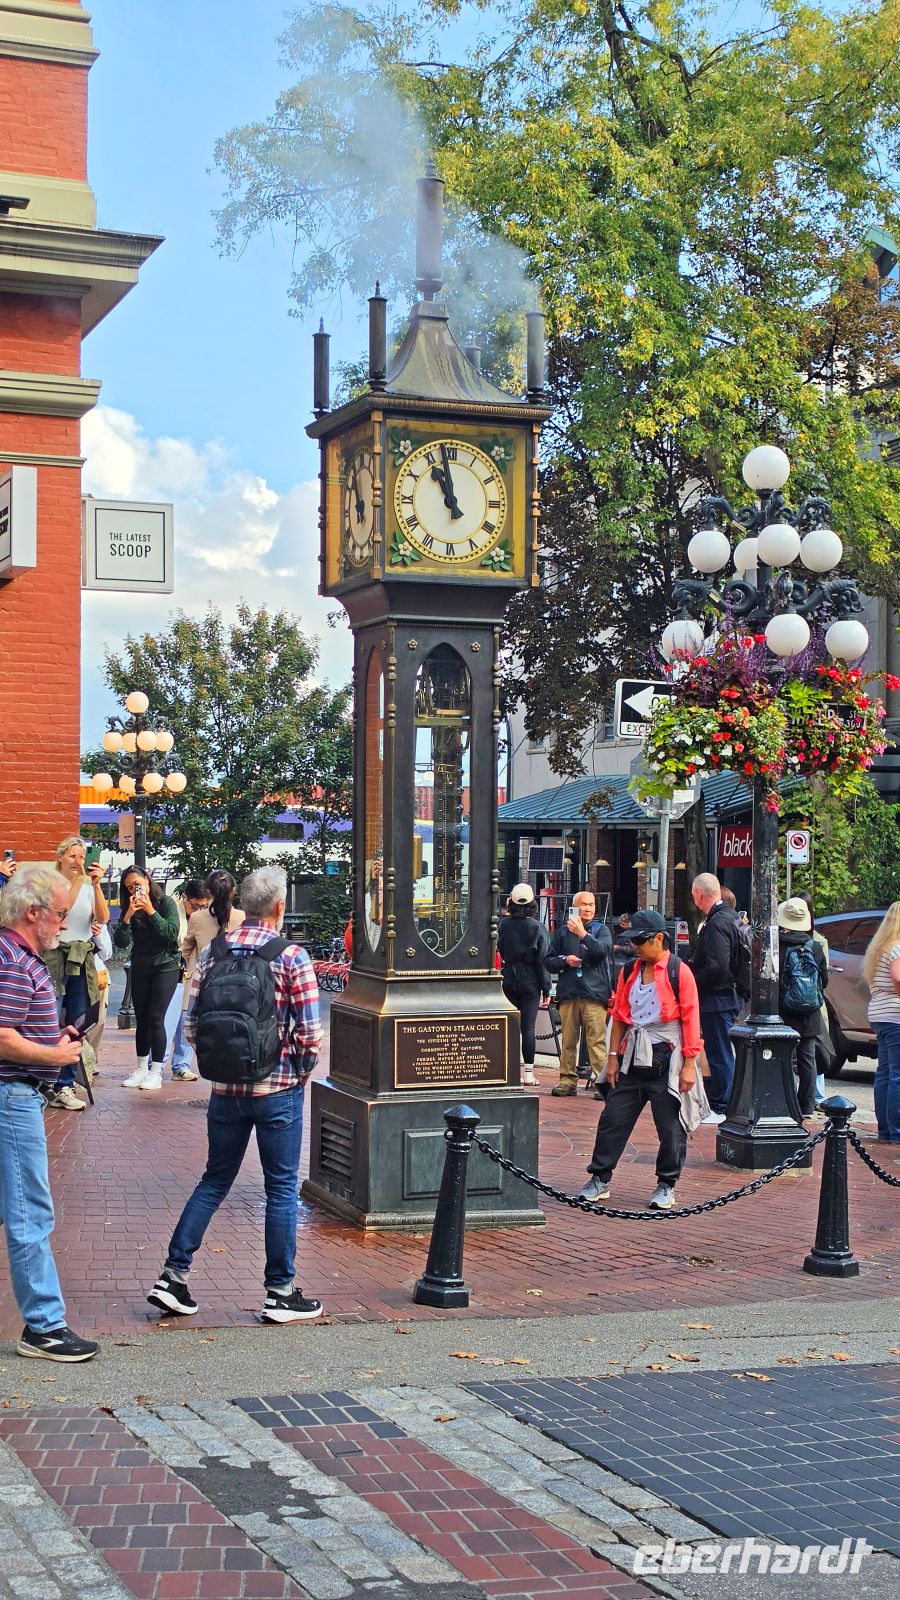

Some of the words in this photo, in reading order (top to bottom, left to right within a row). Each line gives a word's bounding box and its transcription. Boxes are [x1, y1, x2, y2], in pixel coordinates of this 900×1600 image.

[110, 532, 122, 541] THE
[126, 534, 151, 542] LATEST
[110, 544, 151, 557] SCOOP
[723, 832, 752, 857] black
